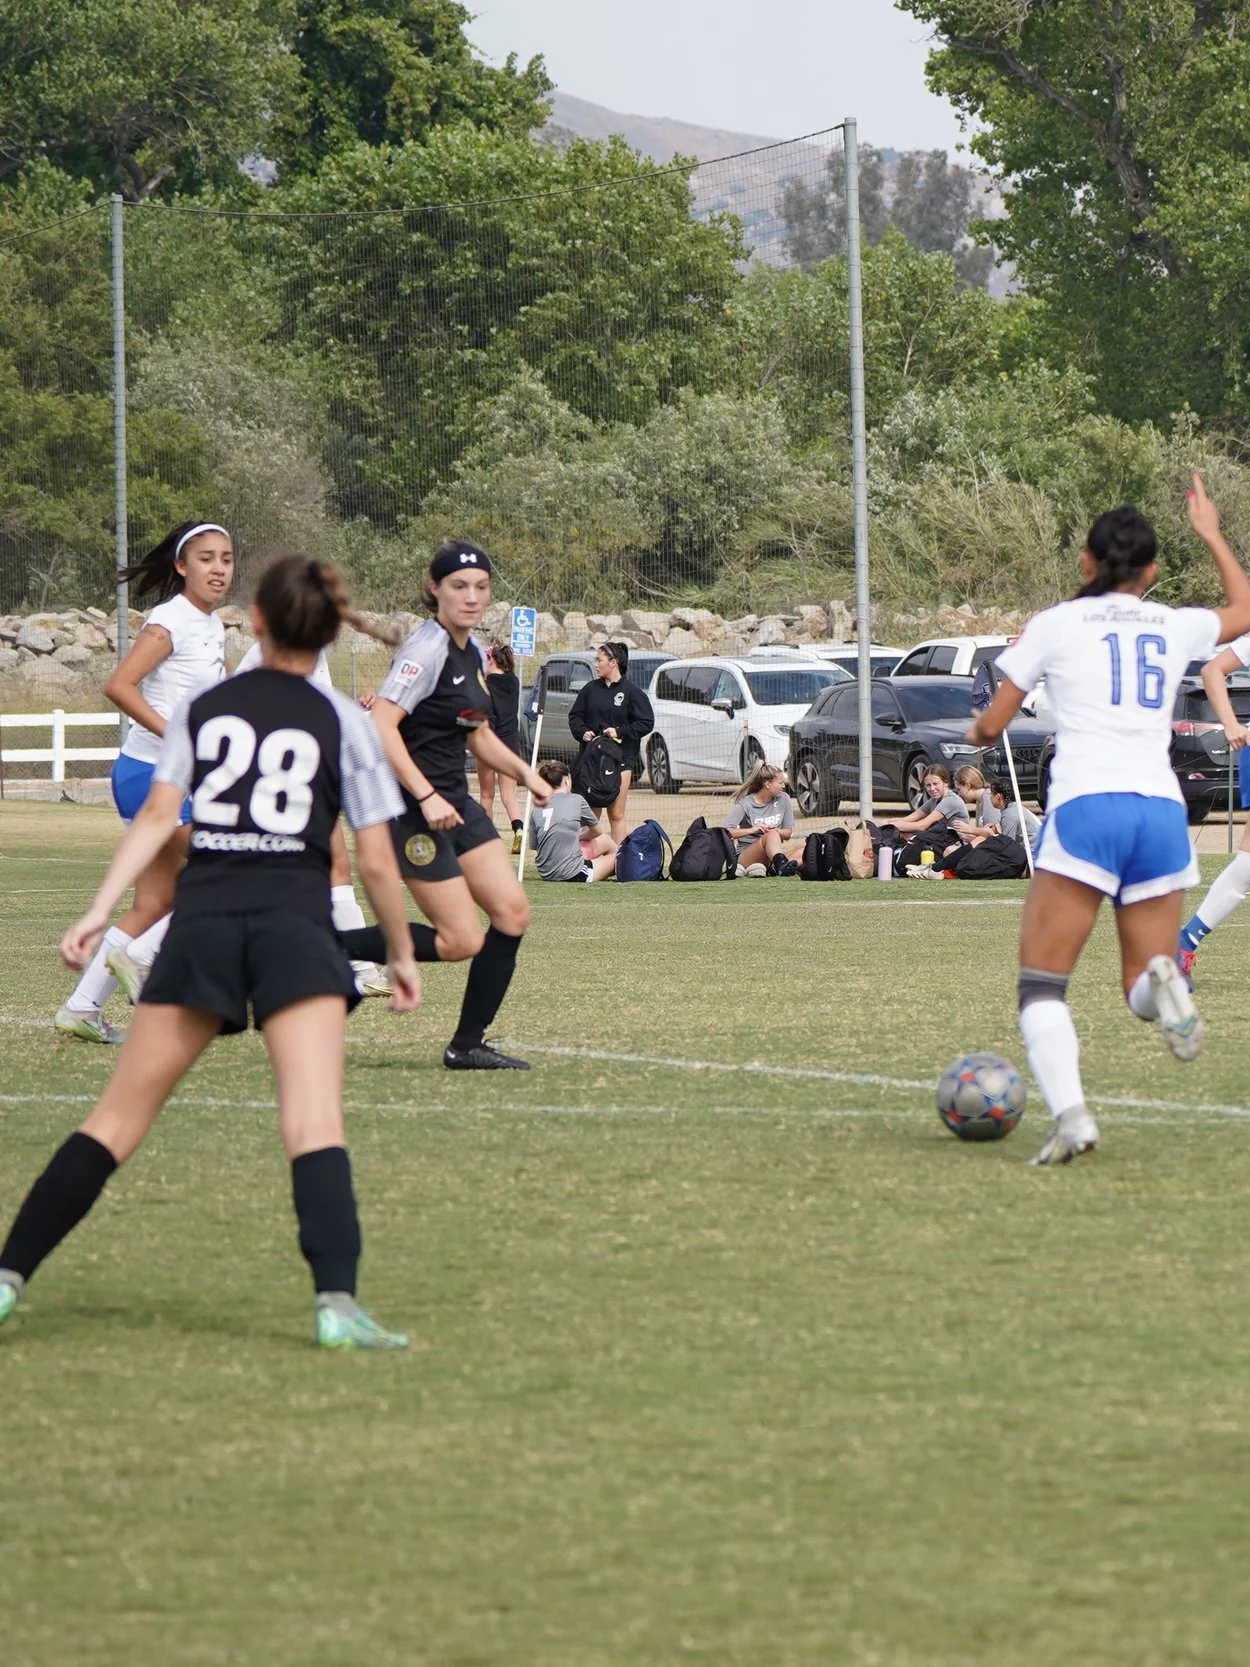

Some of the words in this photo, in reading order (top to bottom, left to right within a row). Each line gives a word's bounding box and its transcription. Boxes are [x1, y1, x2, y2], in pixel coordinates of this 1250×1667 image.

[401, 663, 419, 676] DP
[1101, 632, 1167, 709] 16
[192, 715, 321, 835] 28
